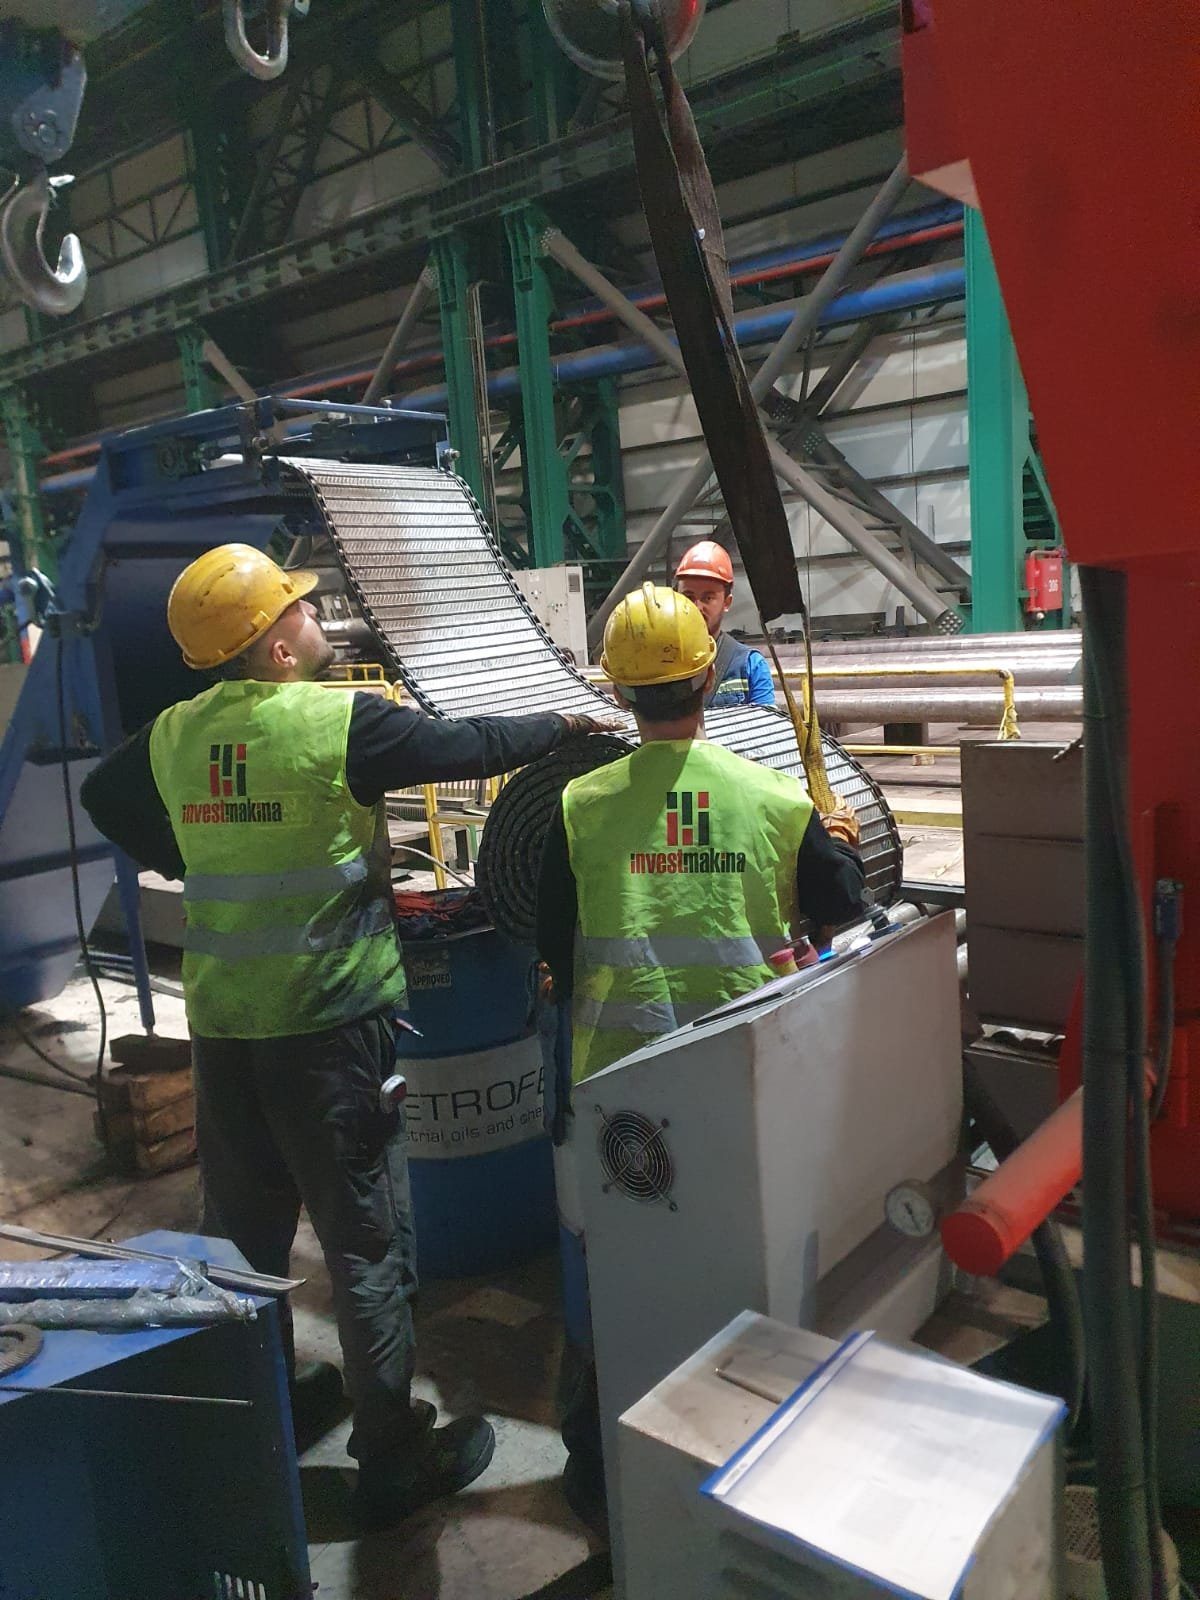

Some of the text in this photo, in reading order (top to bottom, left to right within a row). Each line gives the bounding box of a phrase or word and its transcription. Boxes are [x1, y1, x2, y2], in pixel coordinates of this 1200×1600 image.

[182, 798, 282, 824] investmakina
[630, 848, 746, 874] investmakina
[451, 1127, 480, 1142] oils
[486, 1115, 514, 1135] and
